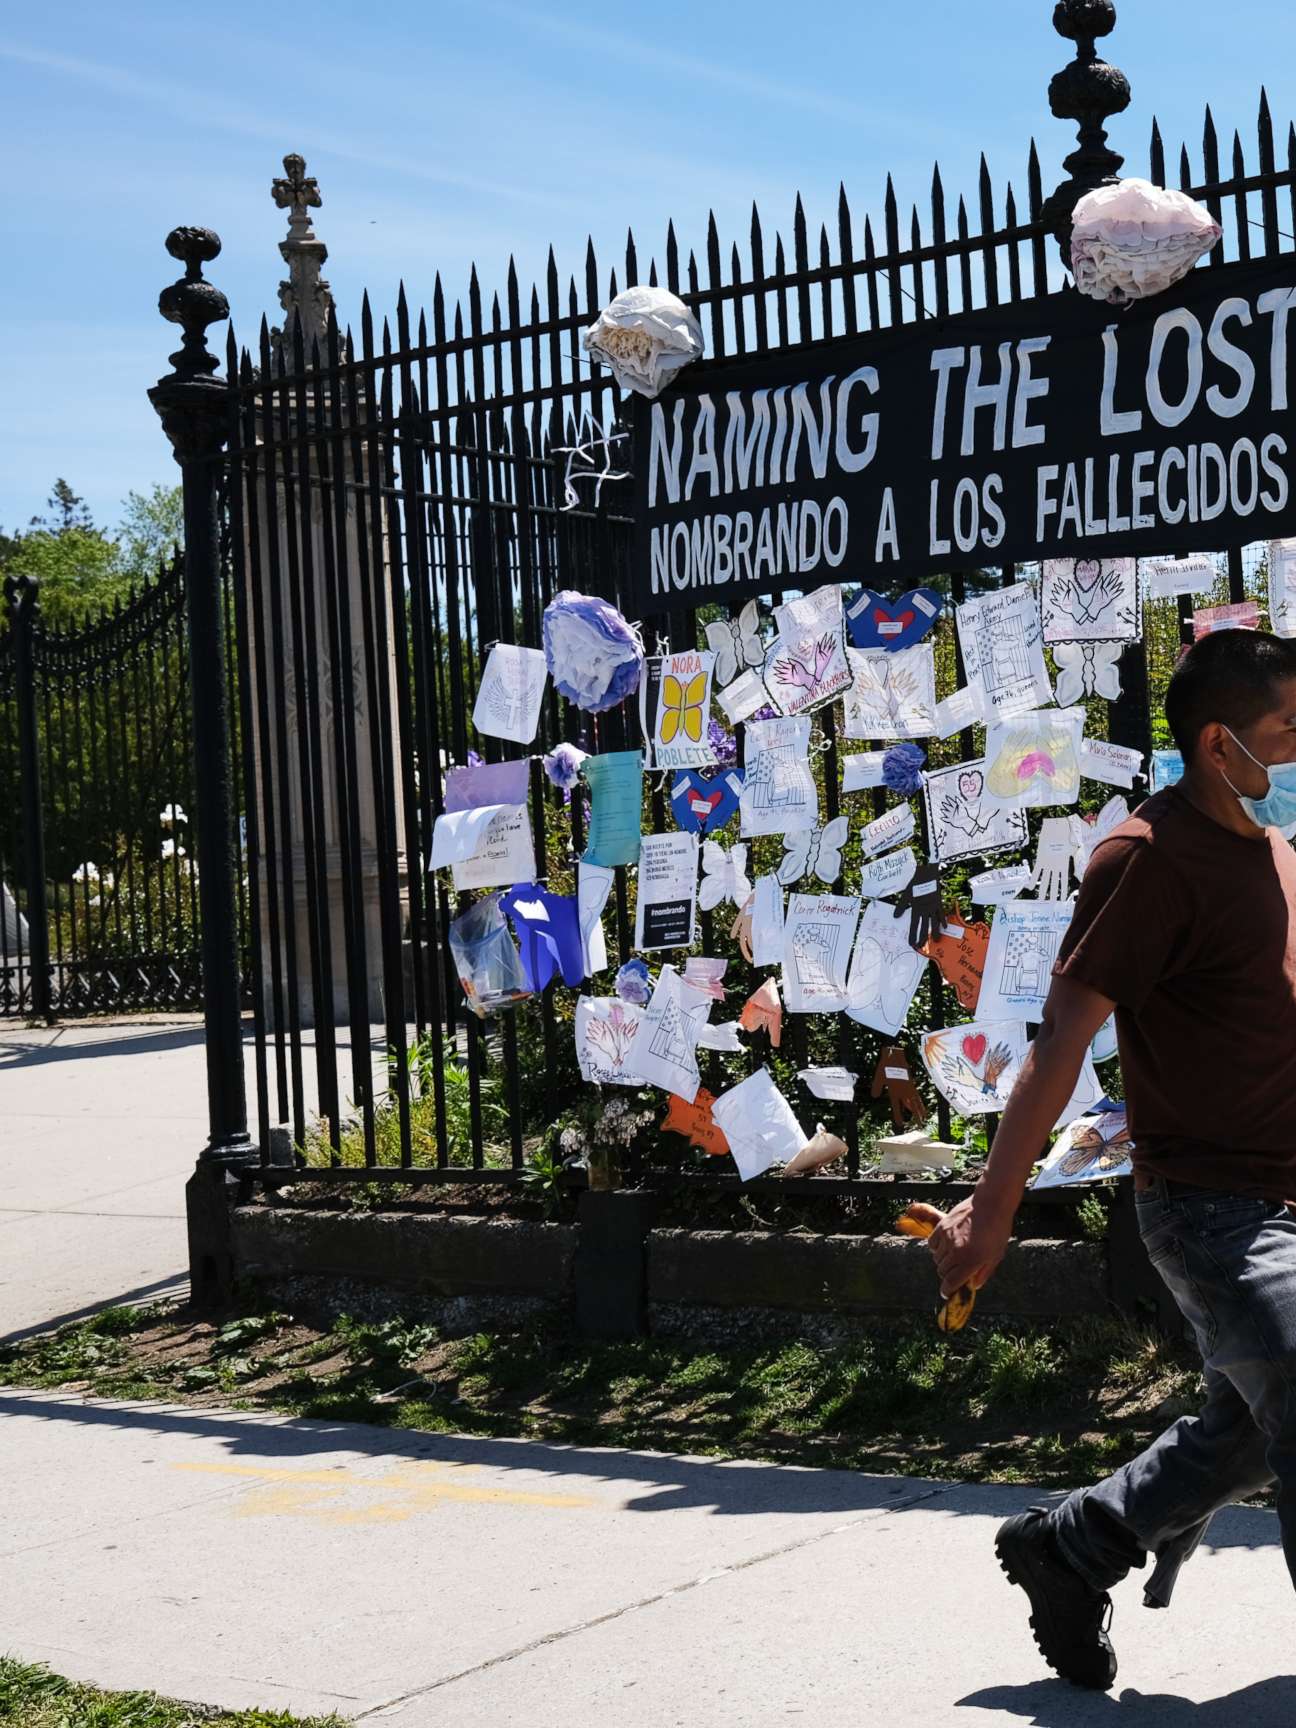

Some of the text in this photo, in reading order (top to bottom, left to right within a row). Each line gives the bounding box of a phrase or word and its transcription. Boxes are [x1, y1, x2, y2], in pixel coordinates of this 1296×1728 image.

[648, 364, 879, 508] NAMING
[929, 335, 1052, 460] THE
[650, 496, 849, 595] NOMBRANDO
[875, 504, 900, 562] A
[929, 474, 1006, 556] LOS
[1036, 432, 1288, 542] FALLECIDOS
[671, 656, 701, 673] NORA
[656, 746, 715, 766] POBLETE
[961, 779, 977, 793] 55
